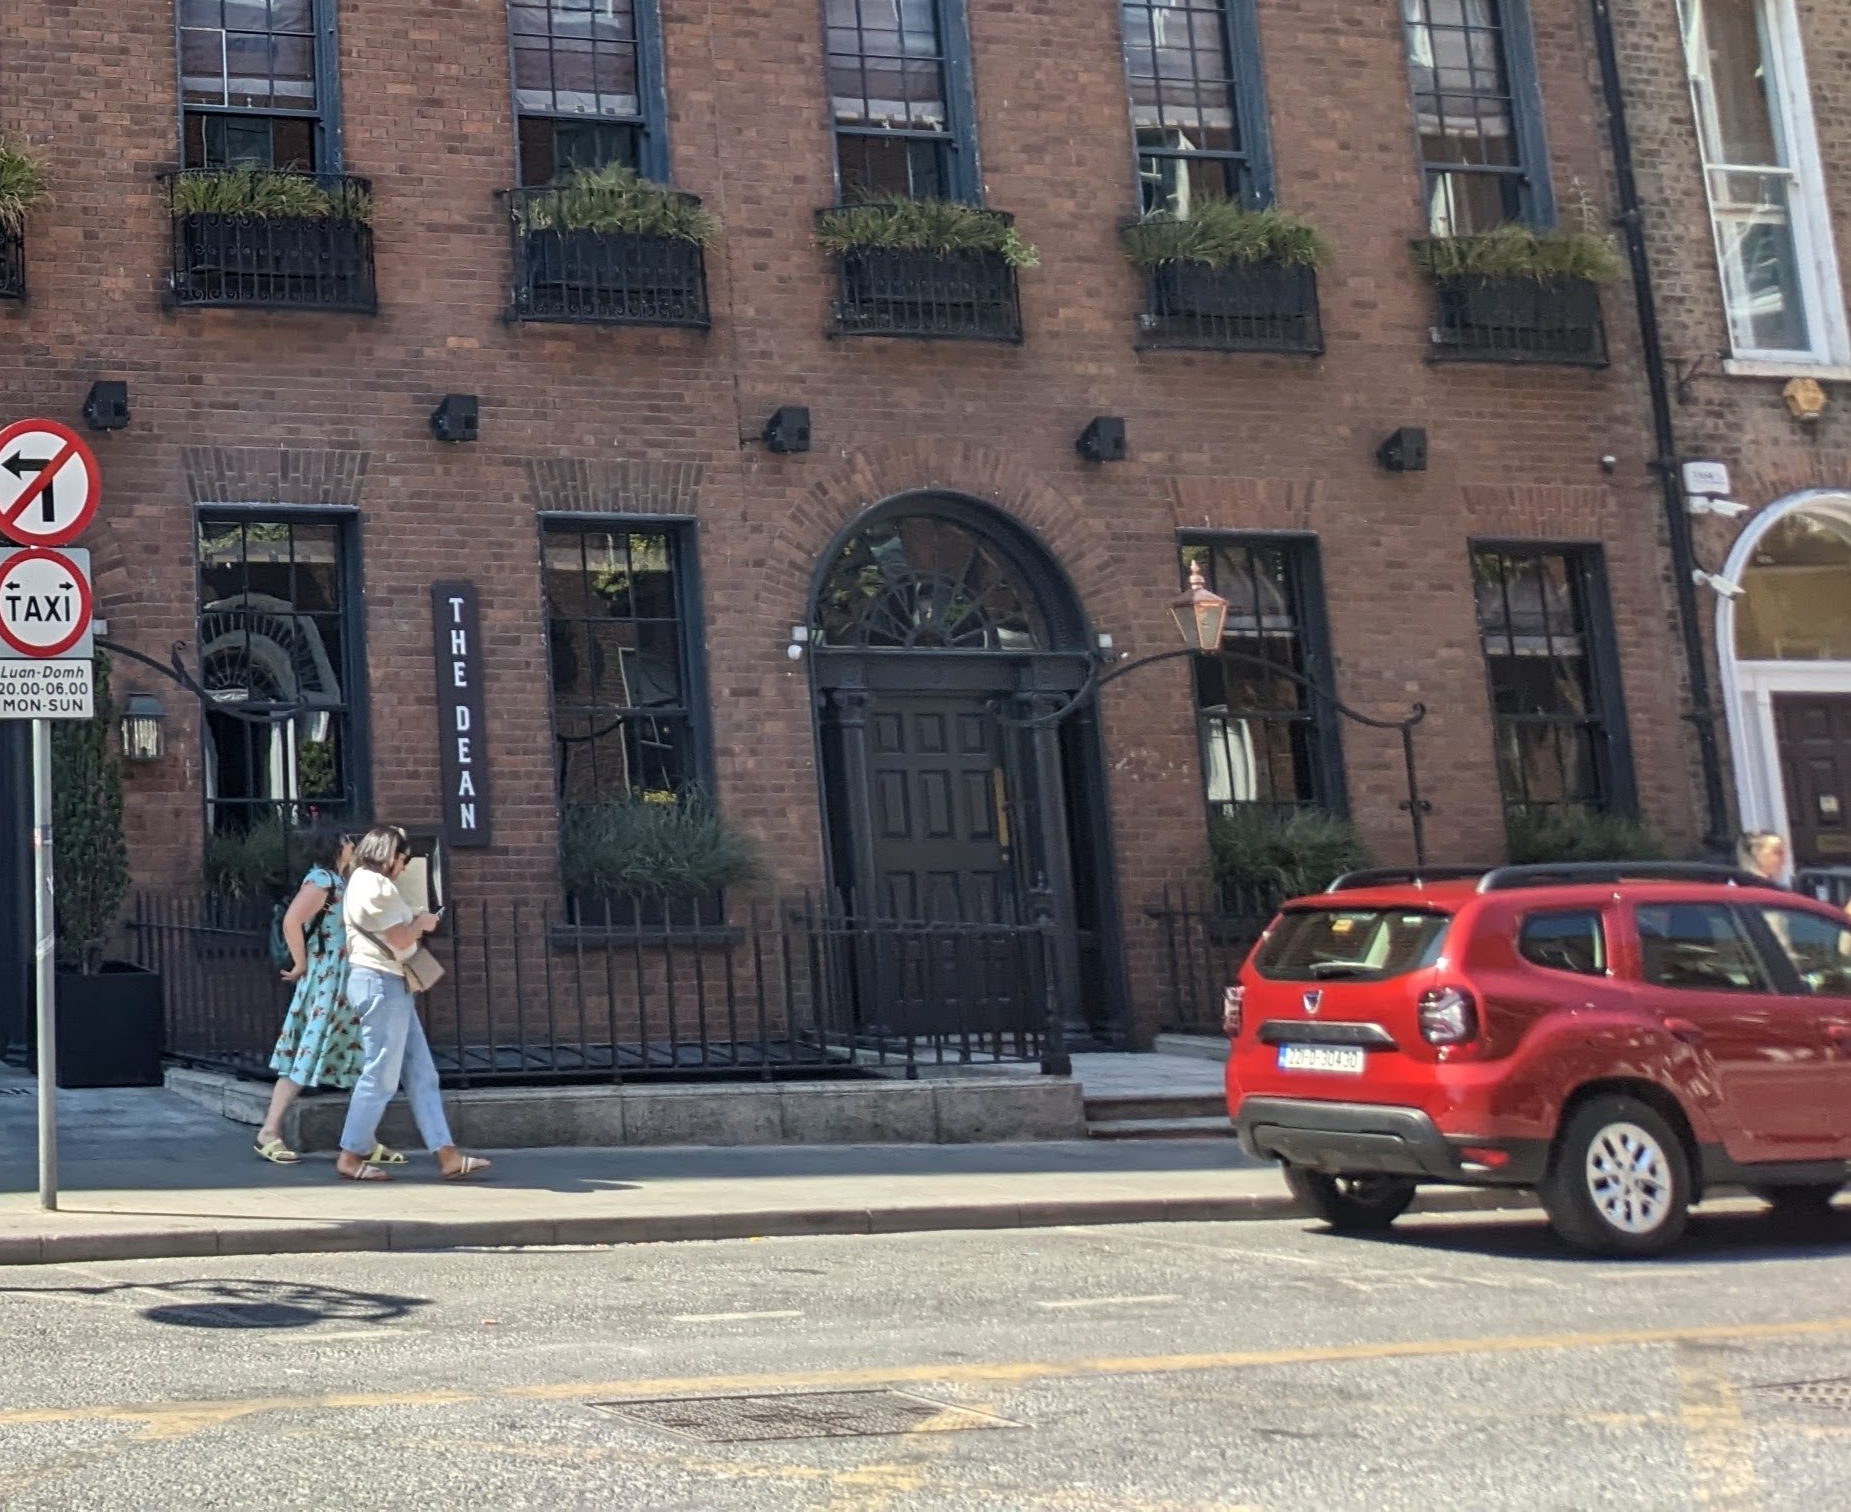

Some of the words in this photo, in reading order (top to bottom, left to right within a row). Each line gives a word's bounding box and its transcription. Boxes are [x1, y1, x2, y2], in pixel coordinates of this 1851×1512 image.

[5, 595, 71, 622] TAXI
[448, 597, 468, 687] THE
[0, 665, 85, 679] Luan-Domh
[3, 698, 83, 712] MON-SUN
[455, 705, 477, 830] DEAN
